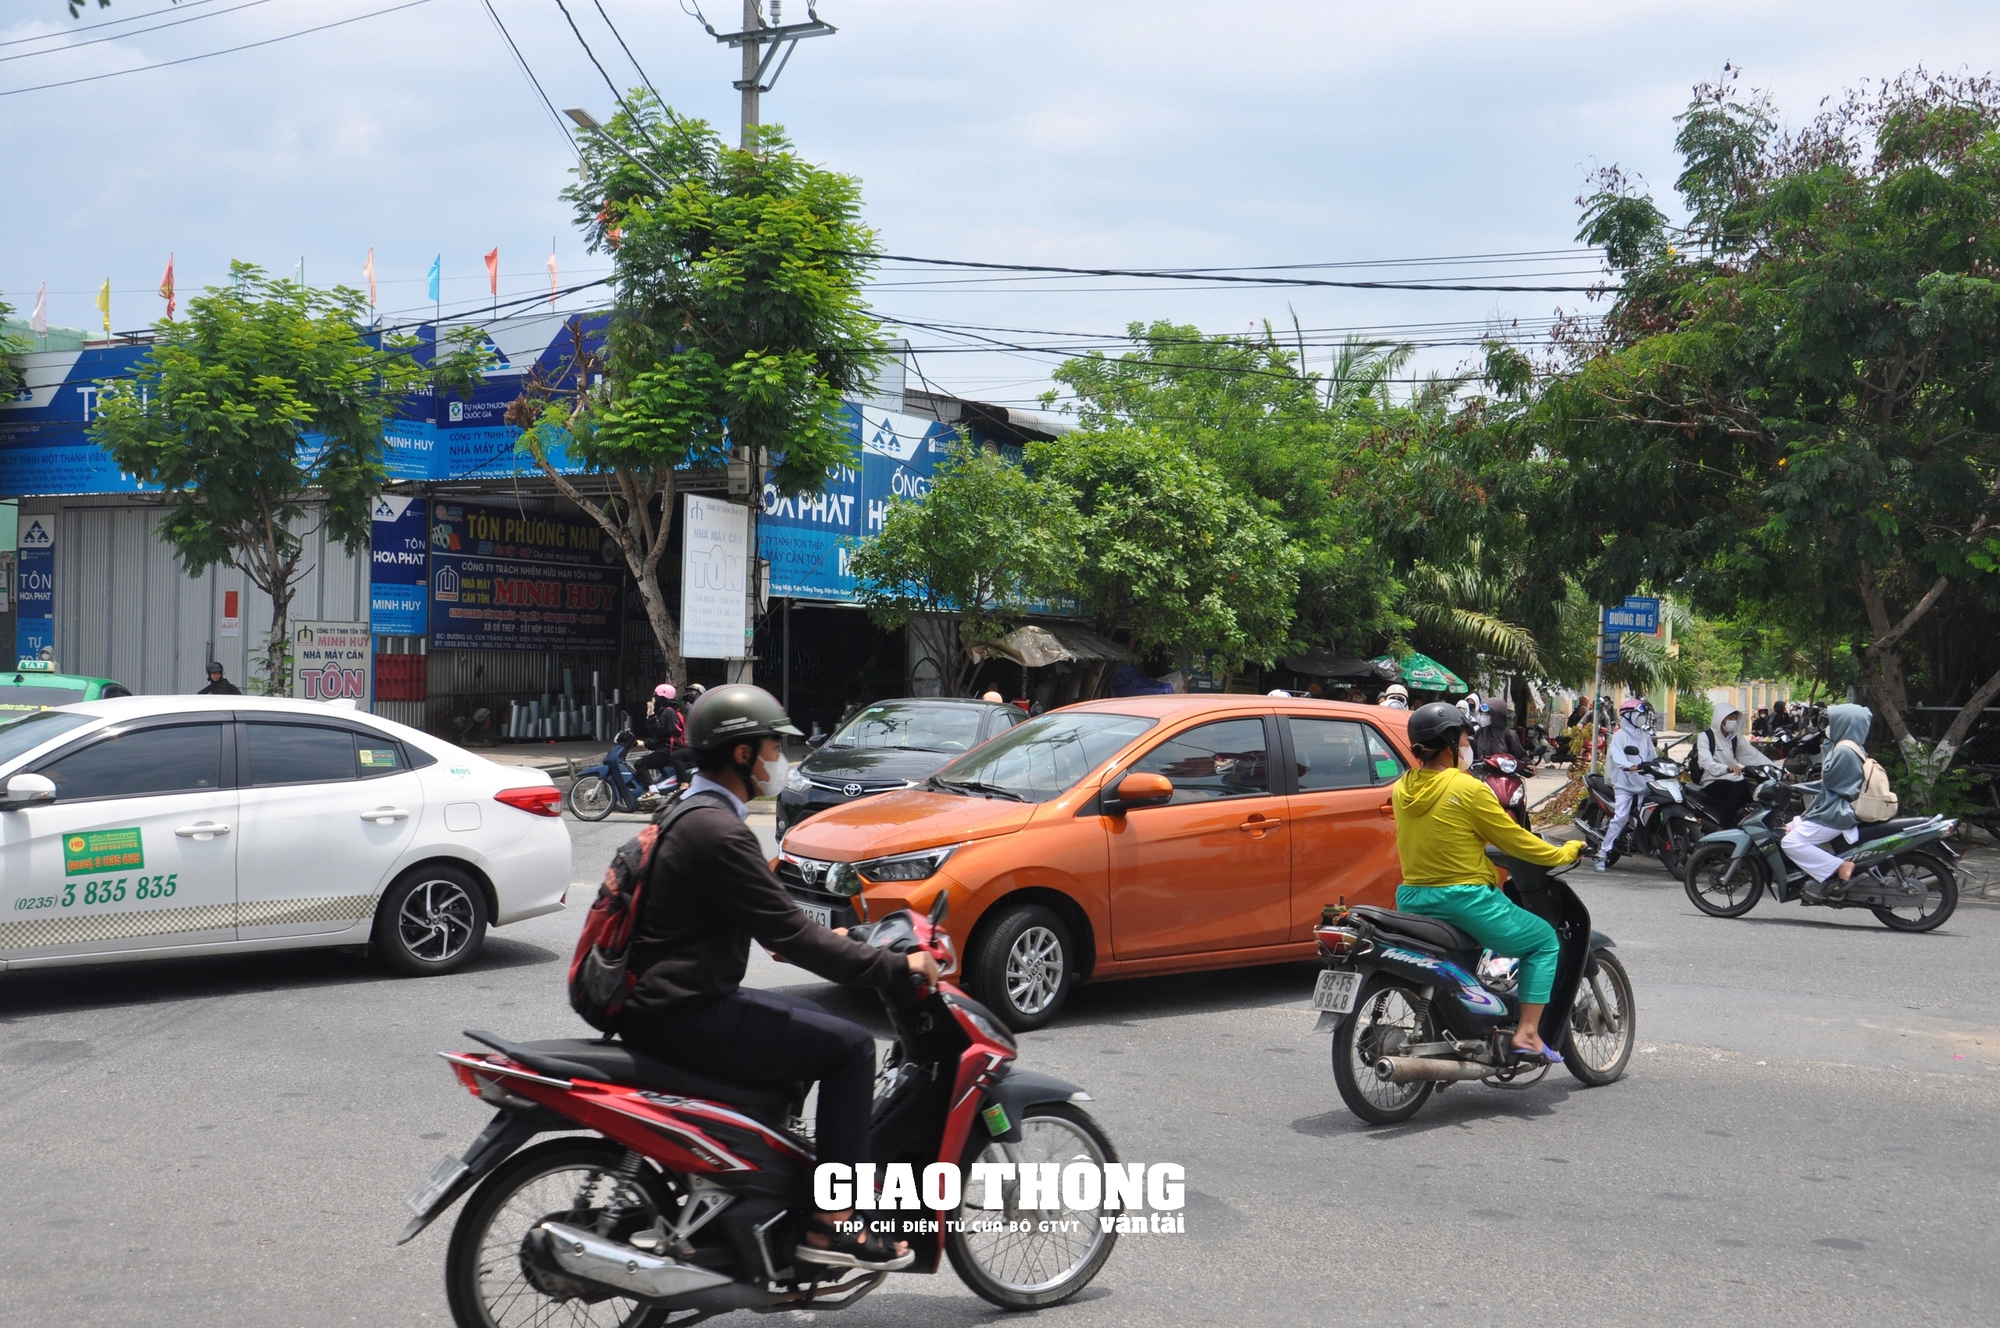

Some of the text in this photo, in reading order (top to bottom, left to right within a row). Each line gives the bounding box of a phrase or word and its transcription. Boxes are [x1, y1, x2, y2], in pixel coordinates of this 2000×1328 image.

[482, 411, 492, 419] GIA
[384, 435, 435, 451] MINH HUY
[450, 431, 471, 442] CÔNG
[473, 431, 483, 440] TY
[484, 430, 503, 439] TNHH
[449, 443, 471, 456] NHÀ
[473, 442, 494, 455] MÁY
[9, 455, 18, 466] TY
[20, 454, 40, 465] TNHH
[42, 452, 59, 467] MỘT
[60, 452, 87, 463] THÀNH
[88, 450, 107, 461] VIÊN
[467, 509, 601, 550] TÔN PHƯƠNG NAM
[694, 526, 743, 545] NHÀ MÁY CÁN
[404, 537, 426, 550] TÔN
[765, 535, 773, 544] TY
[774, 536, 792, 547] TNHH
[793, 538, 808, 549] TÔN
[809, 539, 824, 551] THÉP
[786, 551, 804, 566] CÁN
[806, 552, 824, 567] TÔN
[461, 561, 484, 571] CÔNG
[486, 564, 495, 573] TY
[496, 563, 519, 575] TRÁCH
[520, 565, 541, 578] NHIỆM
[558, 570, 572, 580] HẠN
[573, 569, 586, 579] TÔN
[588, 570, 603, 580] THÉP
[691, 544, 743, 592] TÔN
[20, 570, 51, 590] TÔN
[461, 577, 491, 590] NHÀ MÁY
[462, 591, 490, 605] CÁN TÔN
[494, 577, 617, 611] MINH HUY
[372, 599, 422, 611] MINH HUY
[316, 627, 329, 635] CÔNG
[349, 627, 359, 635] TÔN
[501, 623, 515, 633] THÉP
[28, 636, 42, 652] TỰ
[317, 636, 370, 647] MINH HUY
[303, 648, 364, 660] NHÀ MÁY CÁN
[299, 661, 366, 700] TÔN
[70, 840, 84, 849] HB
[67, 857, 94, 872] (0235)
[103, 855, 121, 866] 835
[123, 852, 141, 864] 835
[61, 873, 179, 908] 3 835 835
[14, 895, 59, 912] (0235)
[1317, 991, 1349, 1010] 8948
